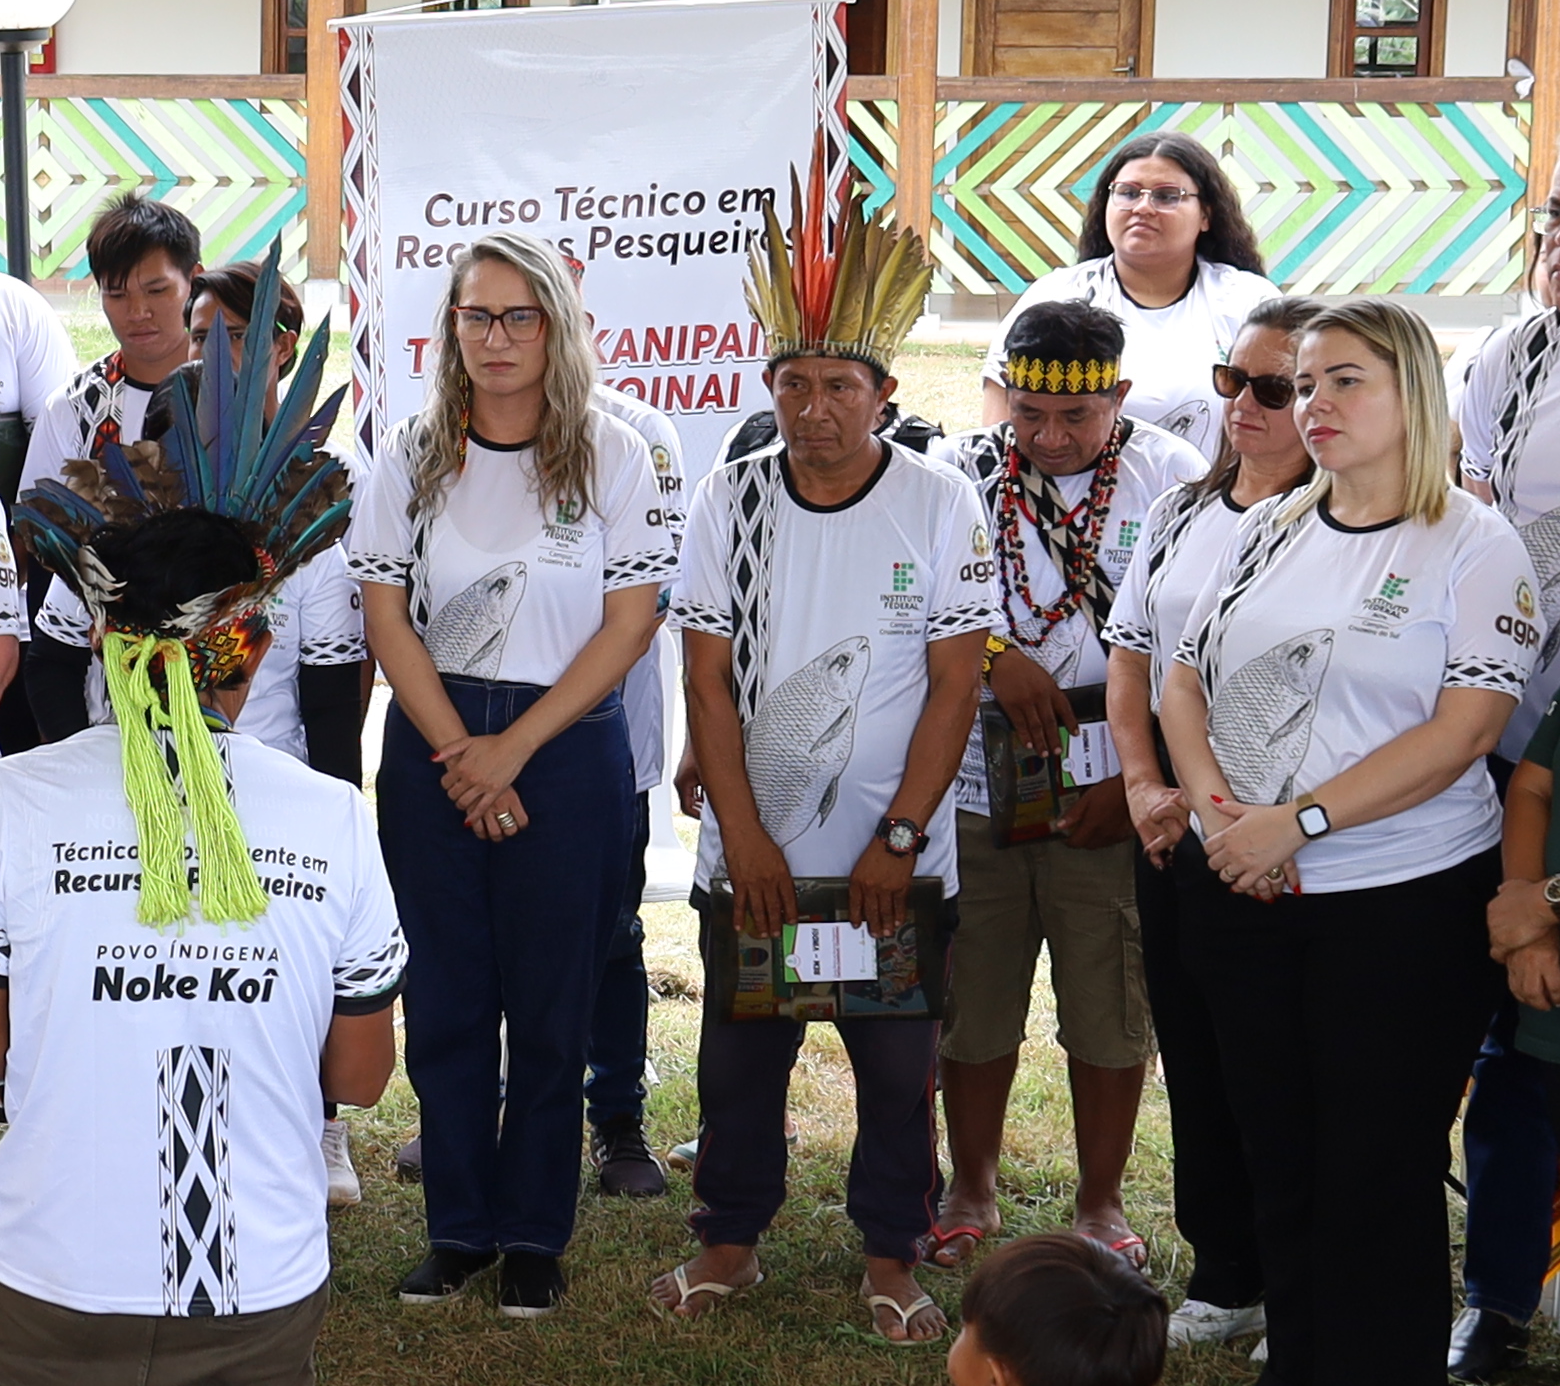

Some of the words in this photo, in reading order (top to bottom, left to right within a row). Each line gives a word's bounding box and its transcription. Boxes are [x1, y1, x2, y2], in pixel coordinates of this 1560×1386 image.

[425, 193, 542, 228] Curso
[555, 183, 706, 222] Técnico
[718, 187, 776, 213] em
[880, 594, 925, 604] INSTITUTO
[52, 840, 141, 864] Técnico
[301, 854, 328, 875] em
[54, 869, 143, 895] Recurs
[96, 944, 158, 961] POVO
[169, 940, 279, 963] ÍNDIGENA
[91, 963, 199, 1003] Noke
[207, 966, 280, 1005] Koî
